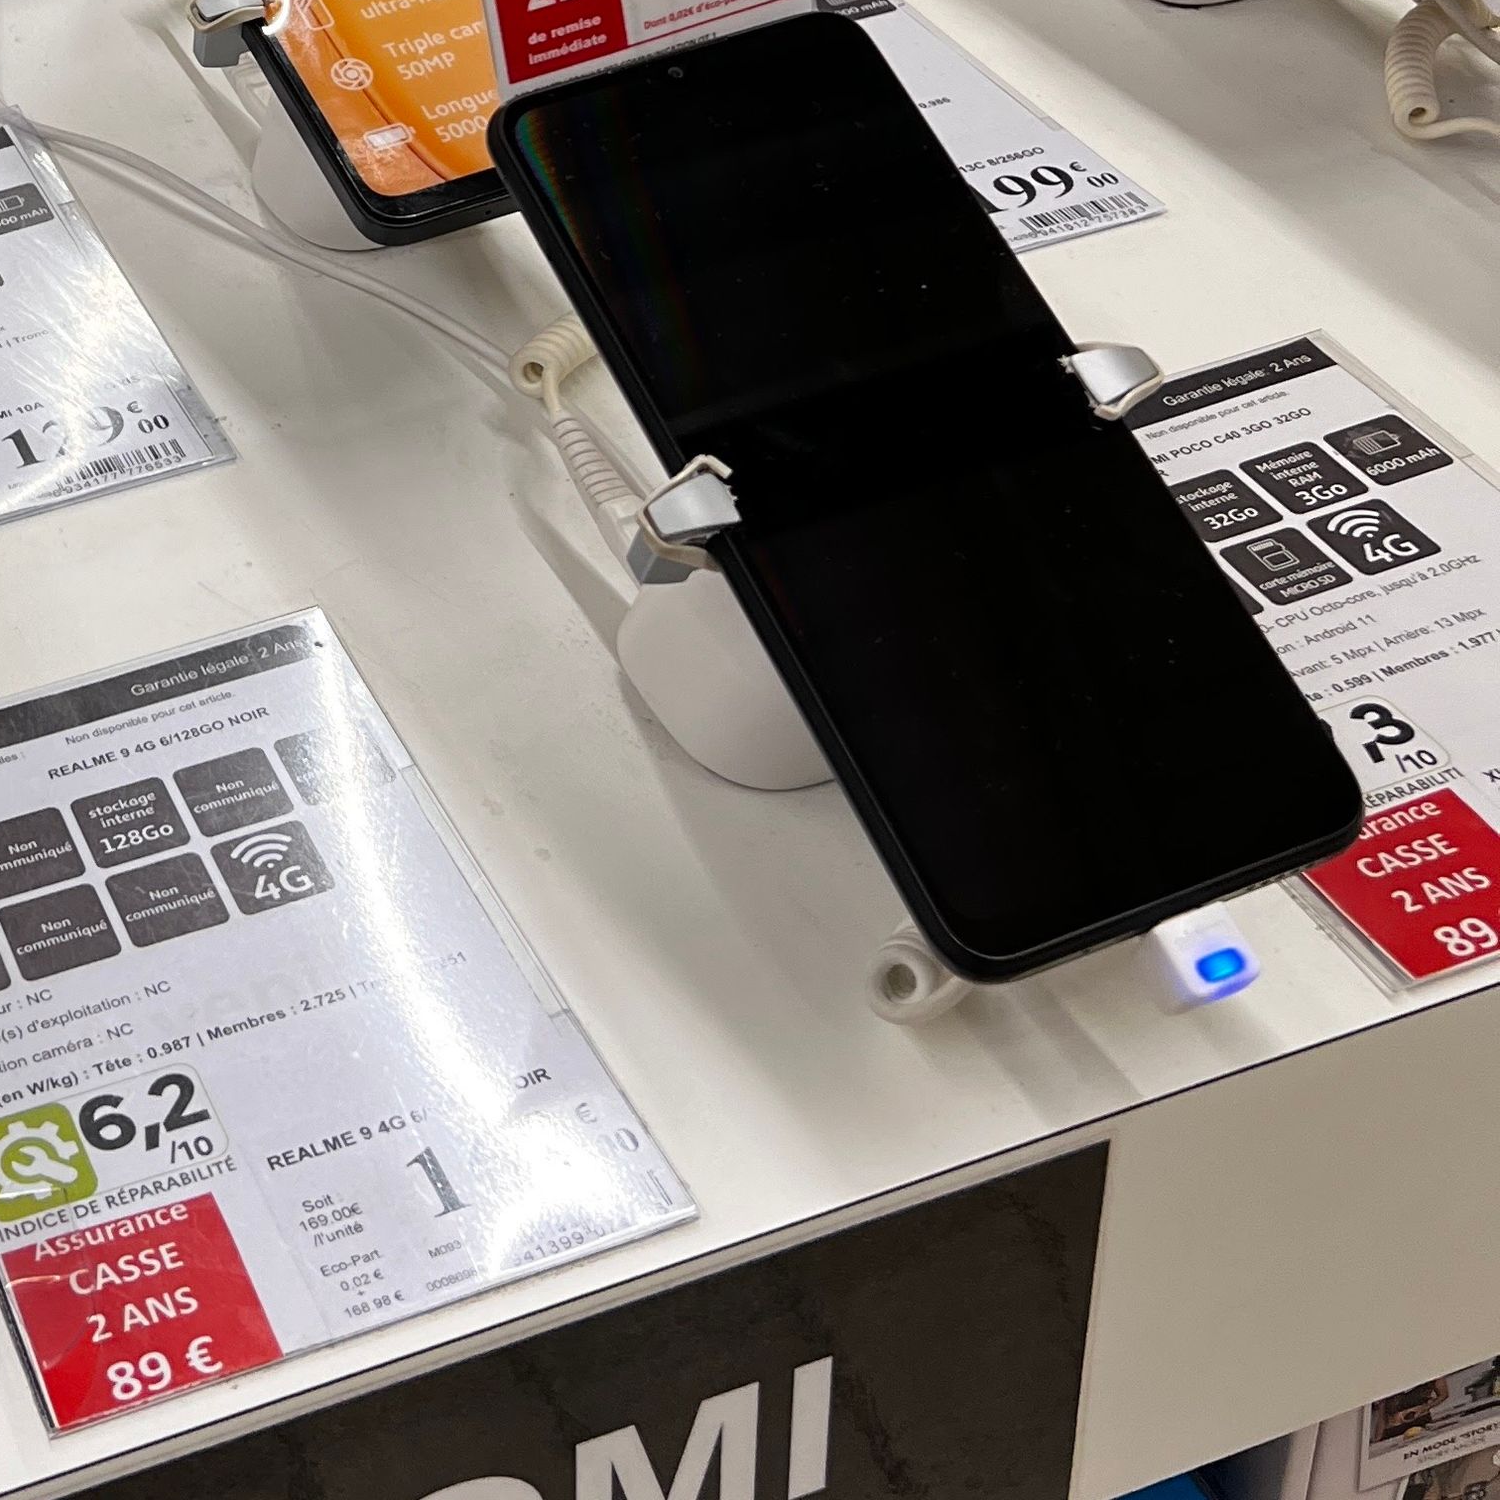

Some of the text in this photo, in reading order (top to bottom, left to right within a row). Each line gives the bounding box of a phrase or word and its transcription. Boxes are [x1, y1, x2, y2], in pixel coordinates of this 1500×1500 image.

[383, 34, 441, 59] Triple
[397, 52, 455, 81] 50MP
[100, 822, 174, 856] 128Go
[1356, 833, 1458, 880] CASSE
[253, 867, 314, 902] 4G
[1391, 866, 1490, 914] 2 ANS
[78, 1071, 211, 1152] 6,2
[69, 1241, 185, 1297] CASSE
[86, 1286, 200, 1344] 2 ANS
[106, 1336, 222, 1401] 89 €
